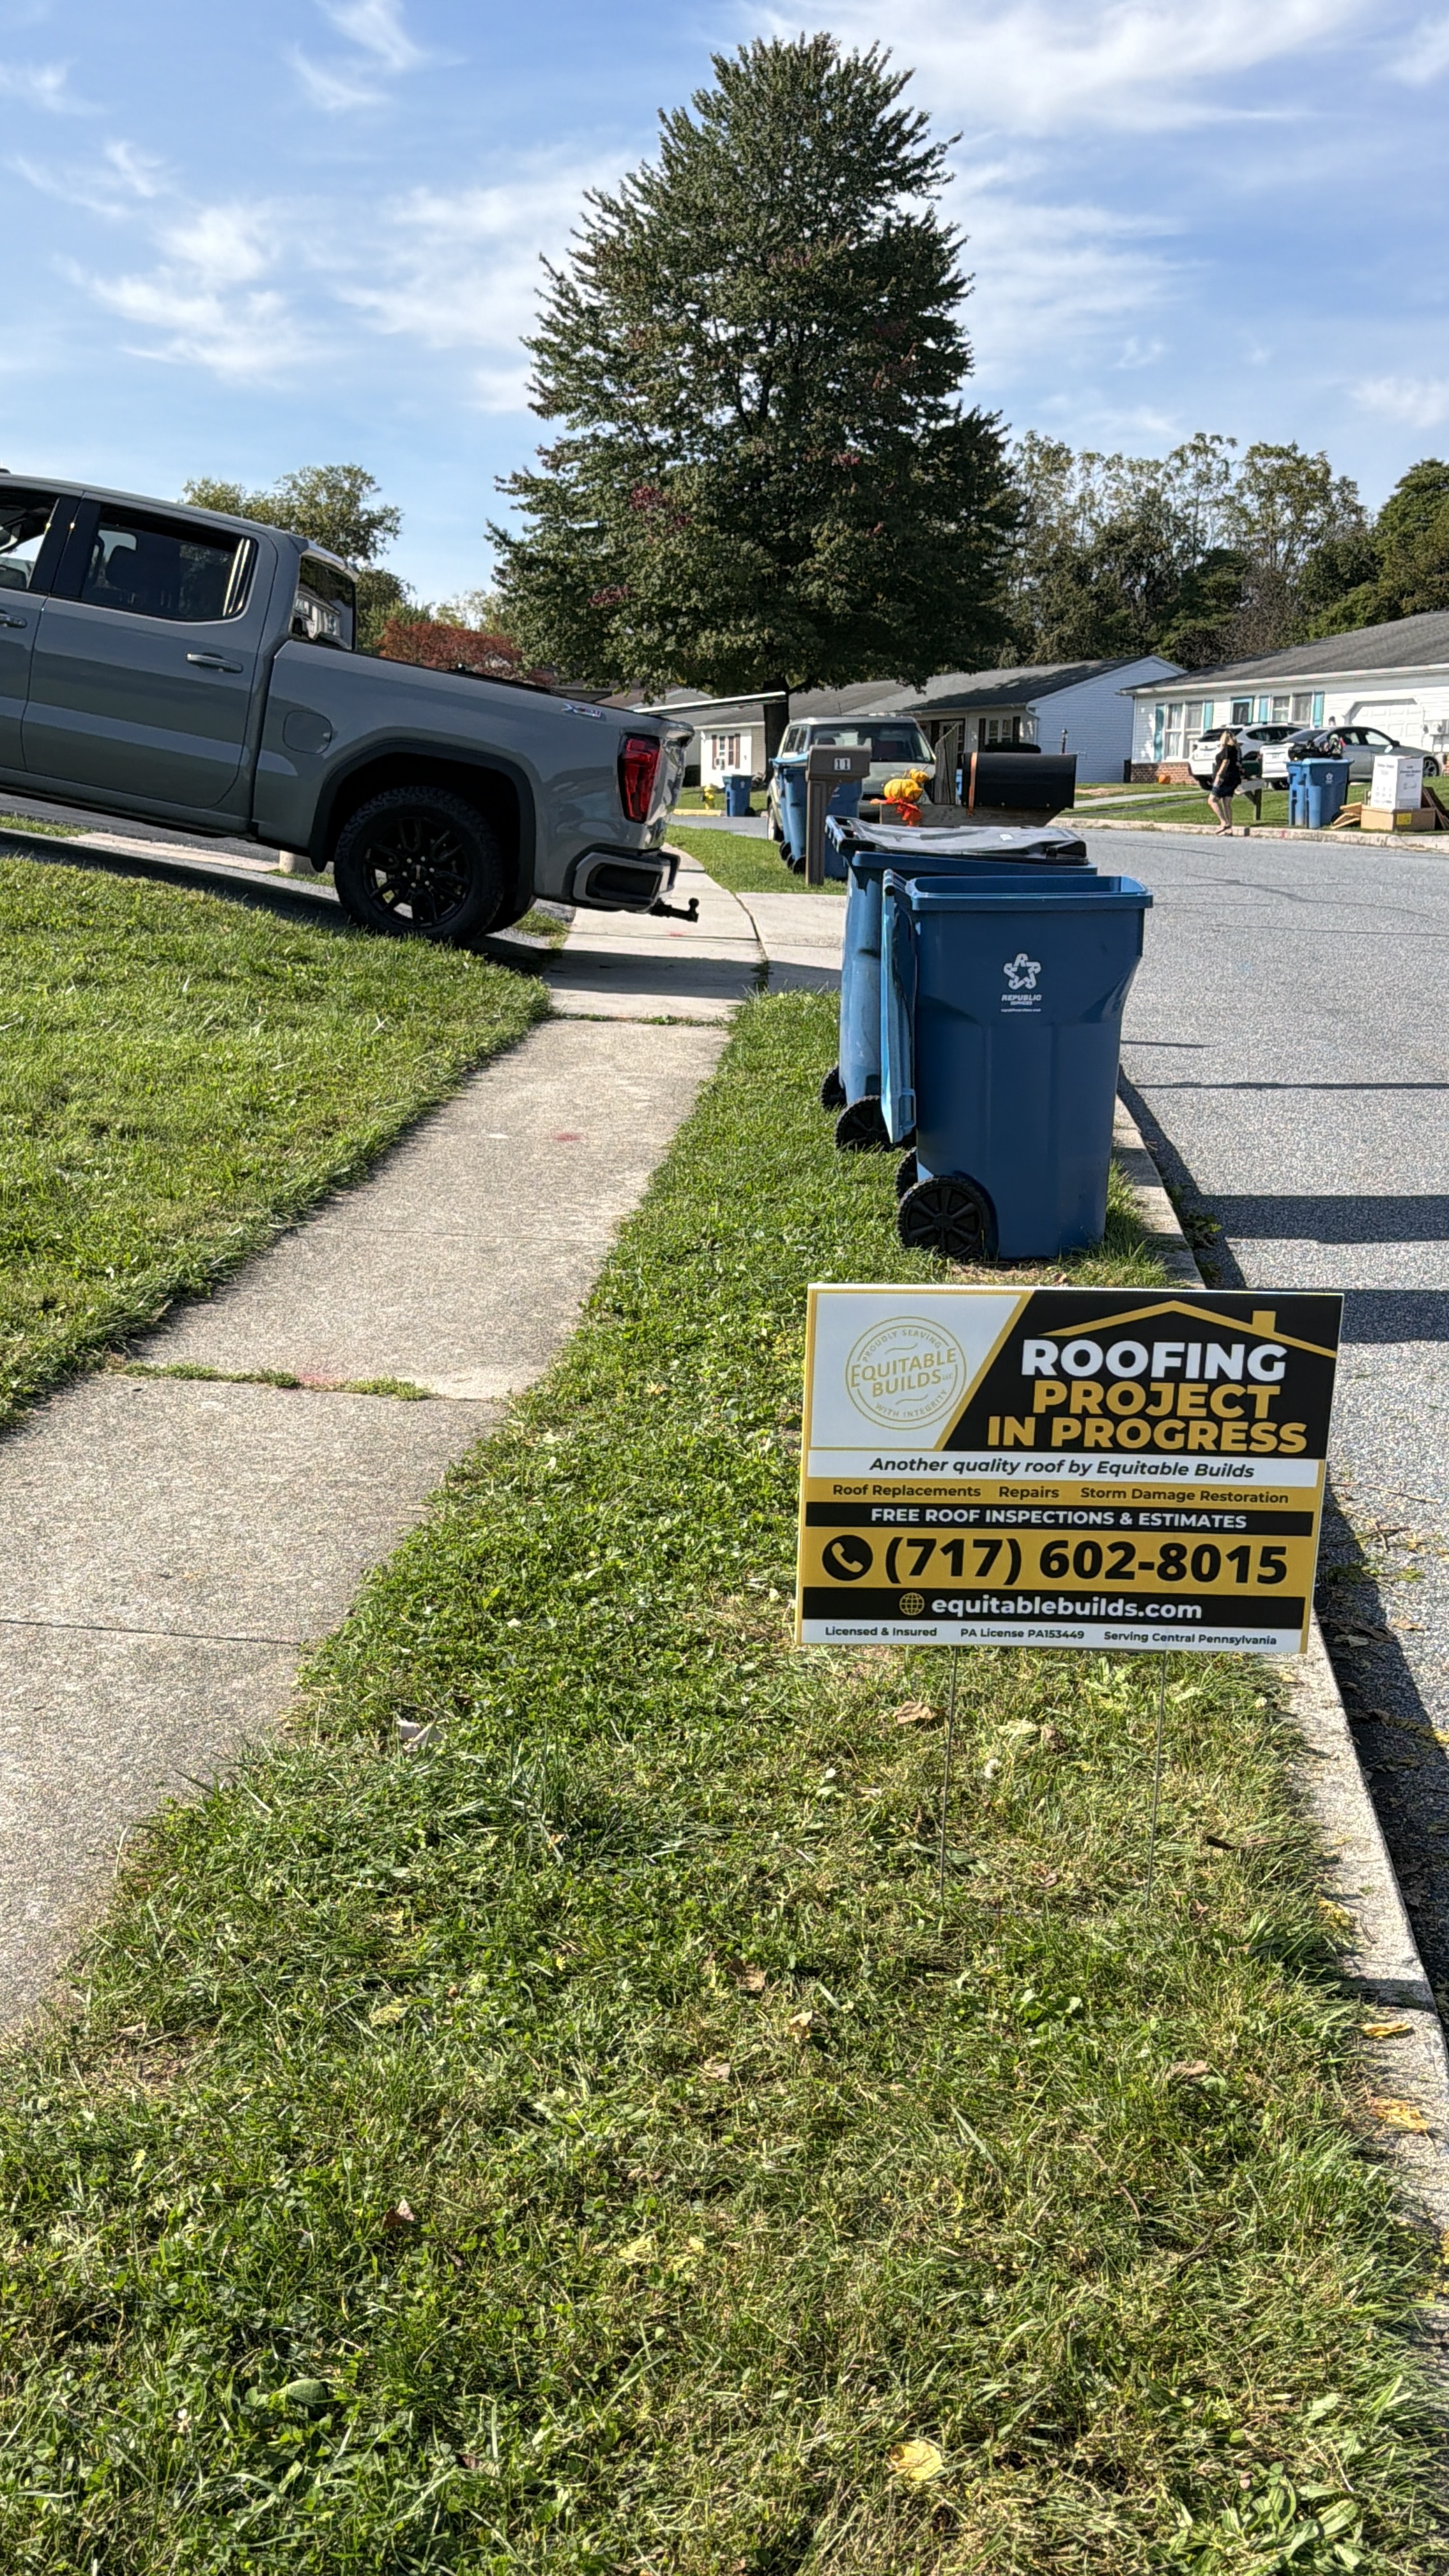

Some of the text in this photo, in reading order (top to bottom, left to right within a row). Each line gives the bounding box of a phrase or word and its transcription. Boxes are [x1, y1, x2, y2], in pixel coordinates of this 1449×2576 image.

[837, 759, 848, 770] 11
[862, 1329, 942, 1363] PROUDLY SERVING
[1022, 1339, 1288, 1381] ROOFING
[850, 1347, 957, 1388] EQUITABLE
[872, 1368, 942, 1398] BUILDS
[875, 1389, 947, 1418] WITH INTEGRITY
[1032, 1379, 1281, 1419] PROJECT
[987, 1416, 1308, 1453] IN PROGRESS
[870, 1457, 1255, 1478] Another quality roof by Equitable Builds
[832, 1484, 1289, 1503] Roof Replacements Repairs Storm Damage Restoration
[871, 1508, 1246, 1529] FREE ROOF INSPECTIONS & ESTIMATES
[885, 1537, 1287, 1586] (717) 602-8015
[931, 1594, 1202, 1619] equitablebuilds.com
[825, 1626, 1277, 1646] Licensed & Insured PA License PA153449 Serving Central Pennsylvania
